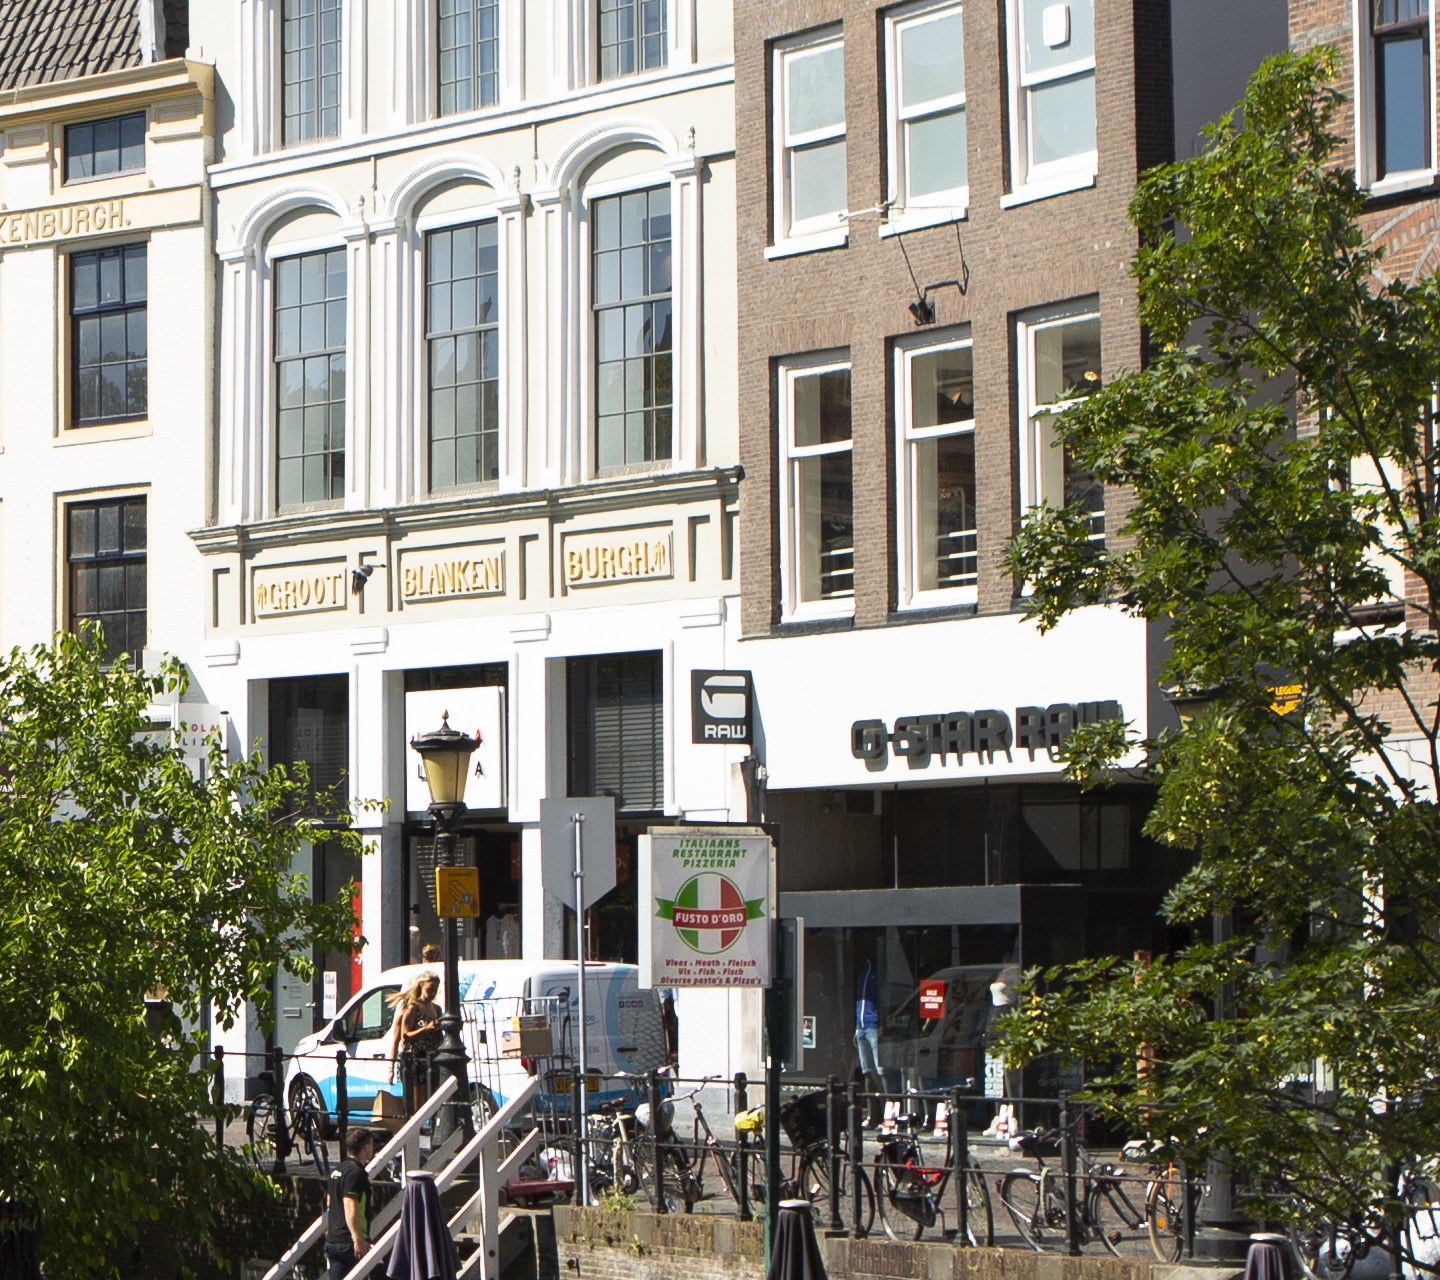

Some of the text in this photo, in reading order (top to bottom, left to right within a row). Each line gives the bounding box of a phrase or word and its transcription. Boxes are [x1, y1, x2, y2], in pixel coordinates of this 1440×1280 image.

[269, 542, 656, 610] GROOT BLANKEN BURGH.
[190, 722, 217, 733] OLA
[704, 724, 746, 739] RAW
[679, 839, 741, 849] ITALIAANS
[672, 849, 748, 859] RESTAURANT
[682, 859, 737, 869] PIZZERIA
[675, 911, 744, 924] FUSTO D'ORO
[727, 958, 757, 967] Fleisch
[677, 967, 744, 976] Vis Fish Fisch
[660, 976, 691, 984] Diverse
[692, 976, 723, 985] pasta's
